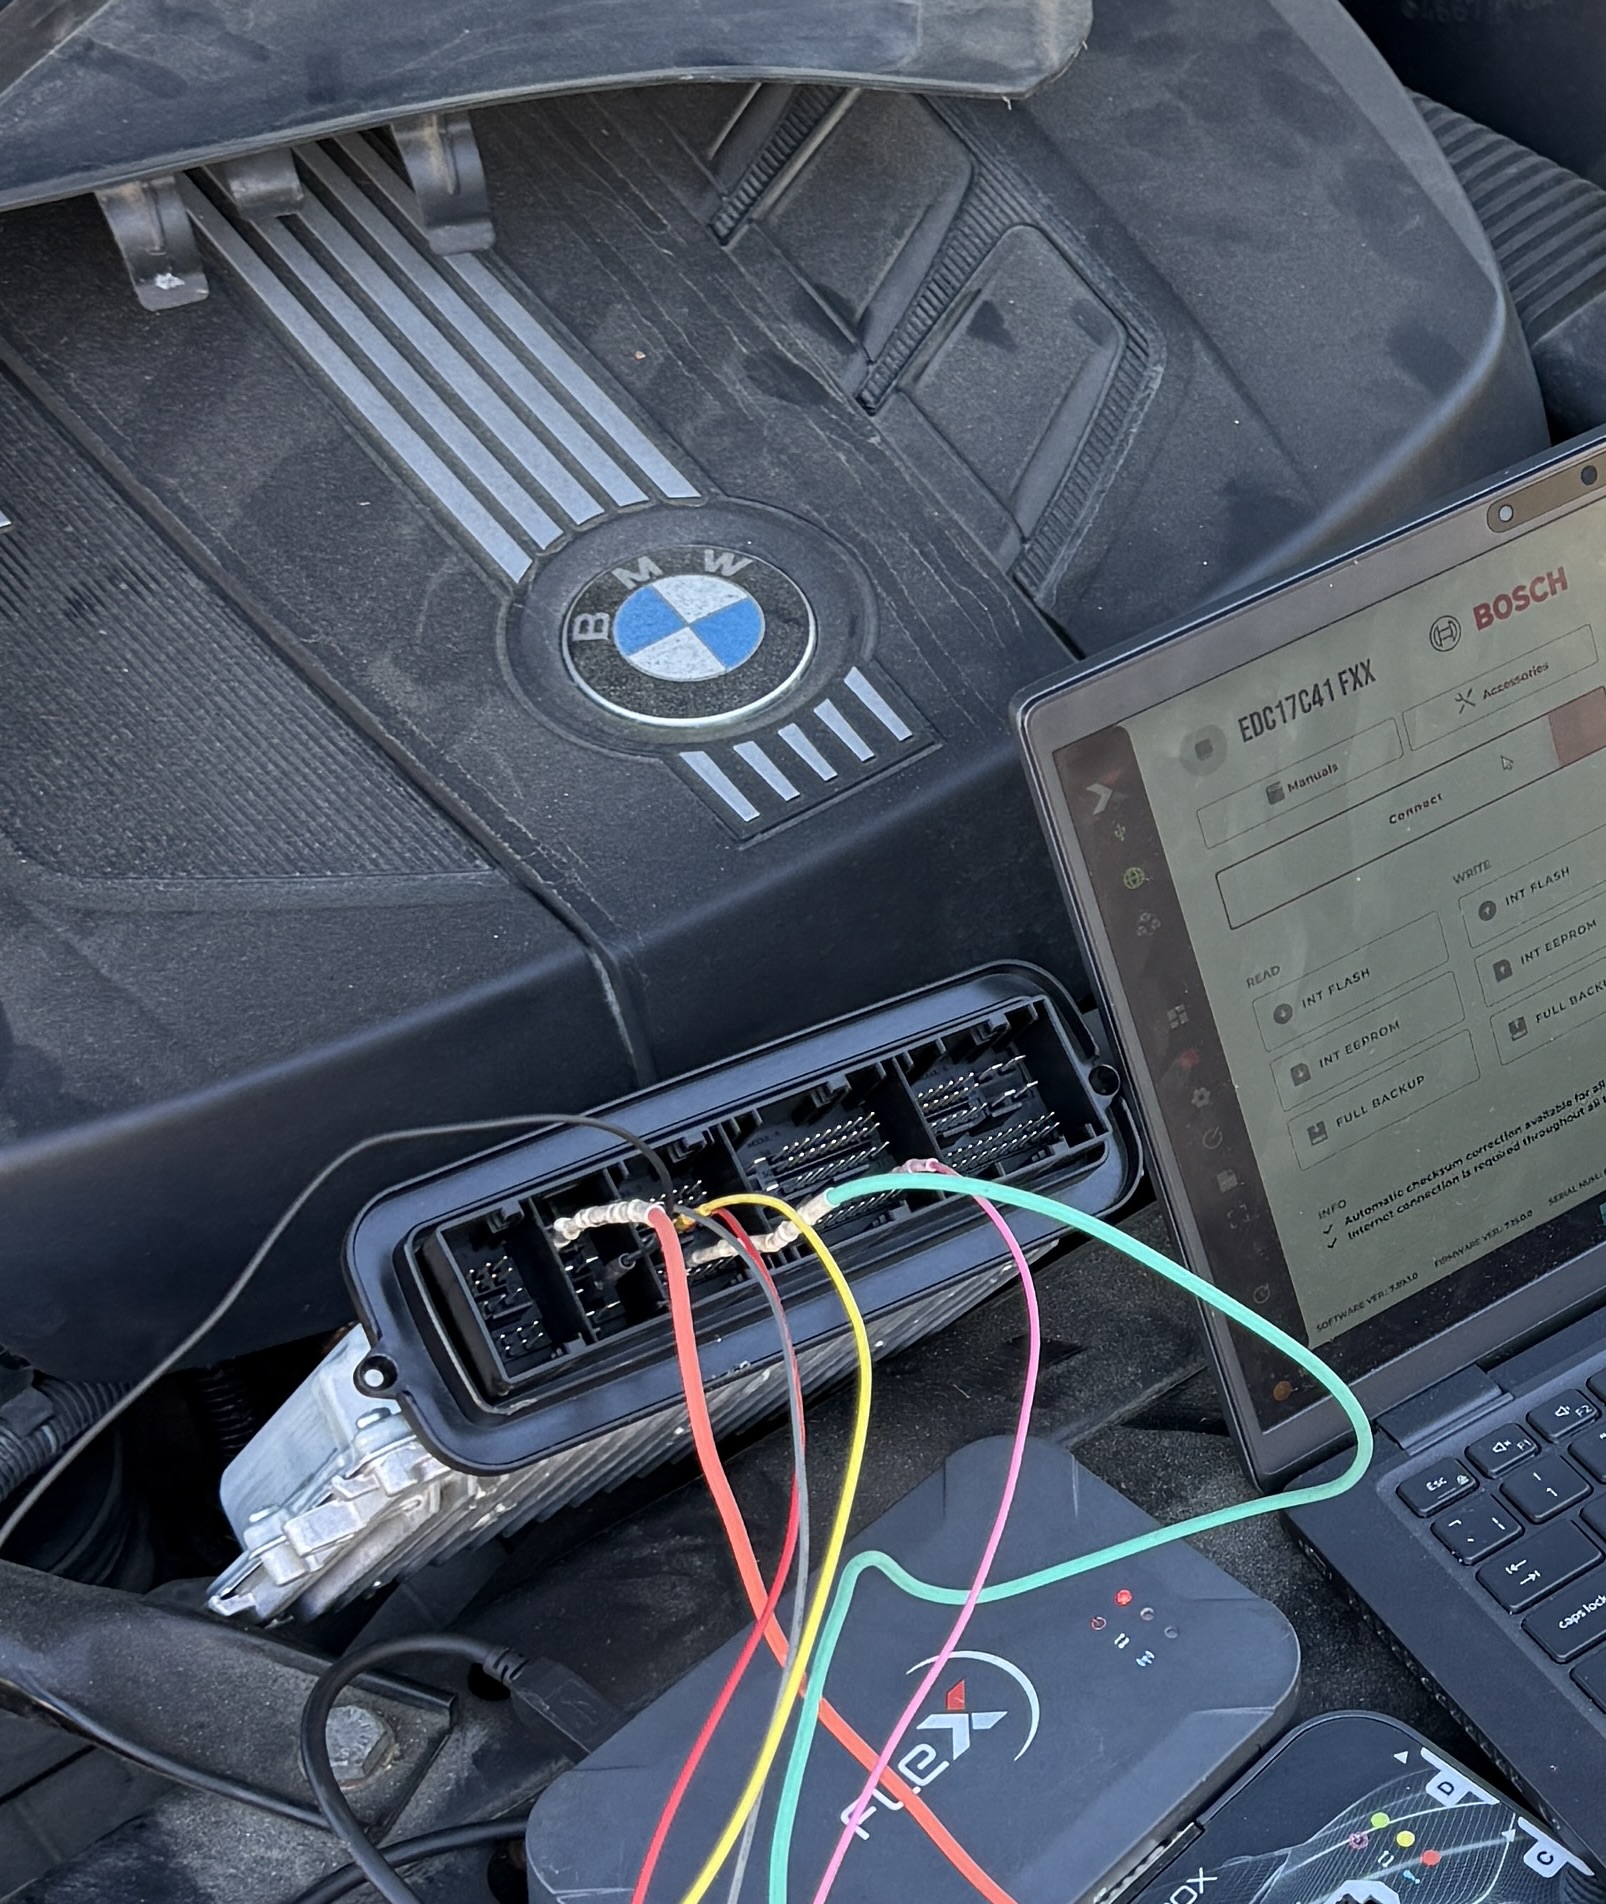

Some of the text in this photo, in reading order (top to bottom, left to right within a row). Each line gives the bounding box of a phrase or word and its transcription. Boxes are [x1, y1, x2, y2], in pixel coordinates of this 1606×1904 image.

[572, 549, 753, 642] BMW
[1471, 565, 1568, 632] BOSCH
[1481, 658, 1550, 701] Accessories
[1236, 657, 1377, 744] EDC17C41 FXX
[1286, 760, 1339, 795] Manuals
[1387, 790, 1443, 826] Connect
[1452, 857, 1491, 886] WRITE
[1504, 864, 1570, 907] INT FLASH
[1519, 916, 1597, 966] INT EEPROM
[1245, 963, 1280, 989] READ
[1301, 965, 1370, 1010] INT FLASH
[1534, 999, 1566, 1025] FULL
[1317, 1018, 1400, 1070] INT EEPROM
[1335, 1072, 1426, 1129] FULL BACKUP
[1343, 1186, 1404, 1229] Automatic
[1405, 1154, 1464, 1196] checksum
[1464, 1122, 1523, 1163] correction
[1523, 1095, 1573, 1132] available
[1573, 1086, 1590, 1105] for
[1591, 1077, 1606, 1095] all
[1347, 1207, 1395, 1243] Internet
[1394, 1172, 1460, 1218] connection
[1460, 1165, 1472, 1182] is
[1471, 1138, 1521, 1176] required
[1521, 1104, 1586, 1149] throughout
[1586, 1095, 1601, 1114] all
[1317, 1197, 1347, 1221] INFO
[1574, 1404, 1592, 1418] F2
[1516, 1438, 1532, 1451] F1
[1426, 1476, 1448, 1492] Esc
[1558, 1609, 1587, 1629] caps
[1438, 1780, 1455, 1797] D
[1536, 1849, 1555, 1867] C
